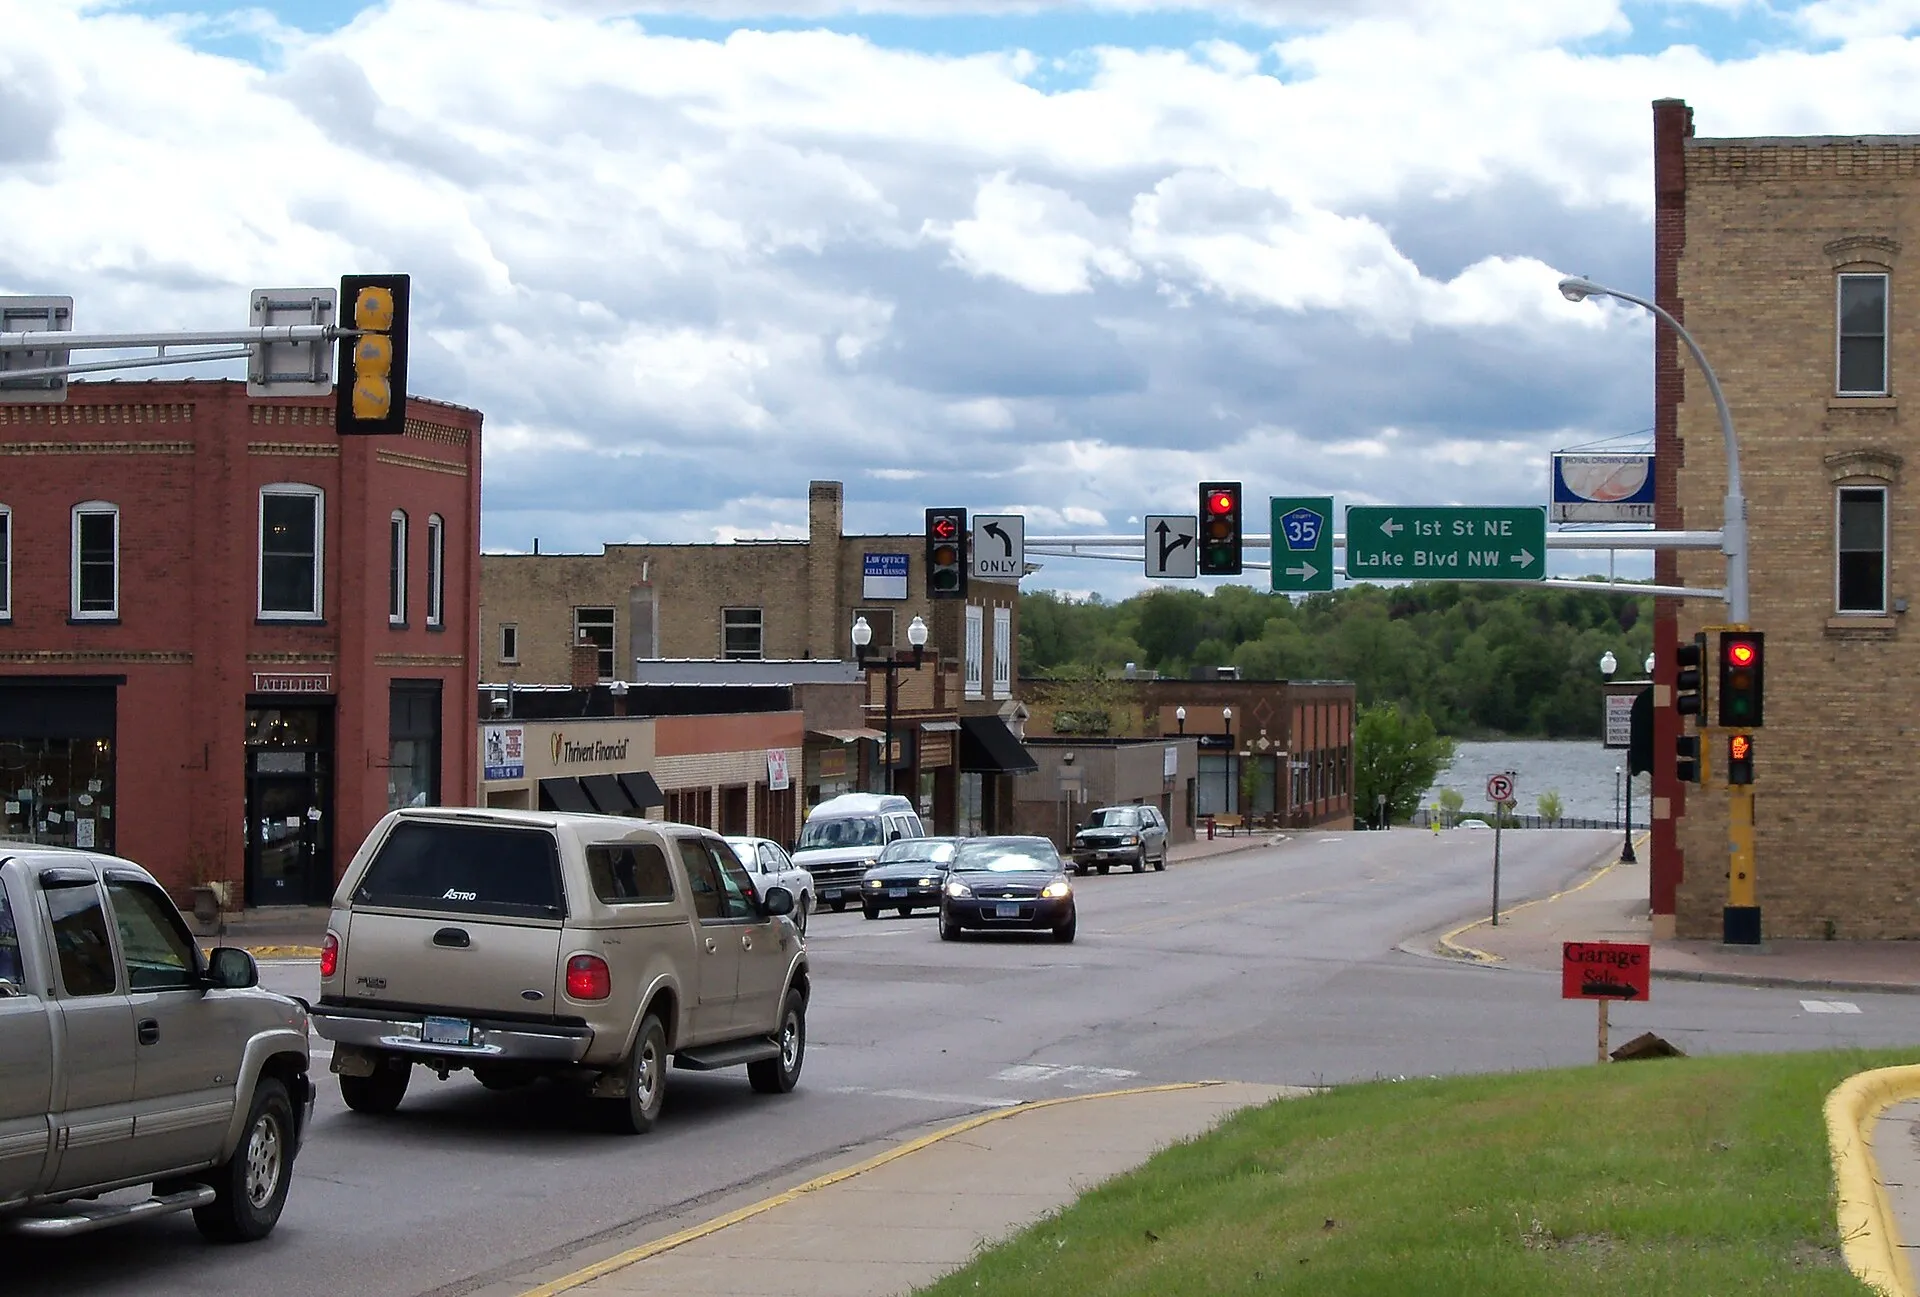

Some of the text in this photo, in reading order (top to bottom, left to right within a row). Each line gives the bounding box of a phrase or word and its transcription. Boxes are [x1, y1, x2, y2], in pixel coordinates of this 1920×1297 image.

[1289, 521, 1316, 542] 35
[1414, 520, 1513, 536] 1st St NE
[866, 556, 906, 564] LAW OFFICE
[980, 560, 1017, 572] ONLY
[1356, 550, 1500, 567] Lake Blvd NW
[262, 679, 323, 692] ATELIER
[564, 738, 629, 763] Thrivent Financial
[442, 888, 477, 900] ASTRO
[1564, 943, 1642, 969] Garage
[1583, 969, 1618, 984] Sale
